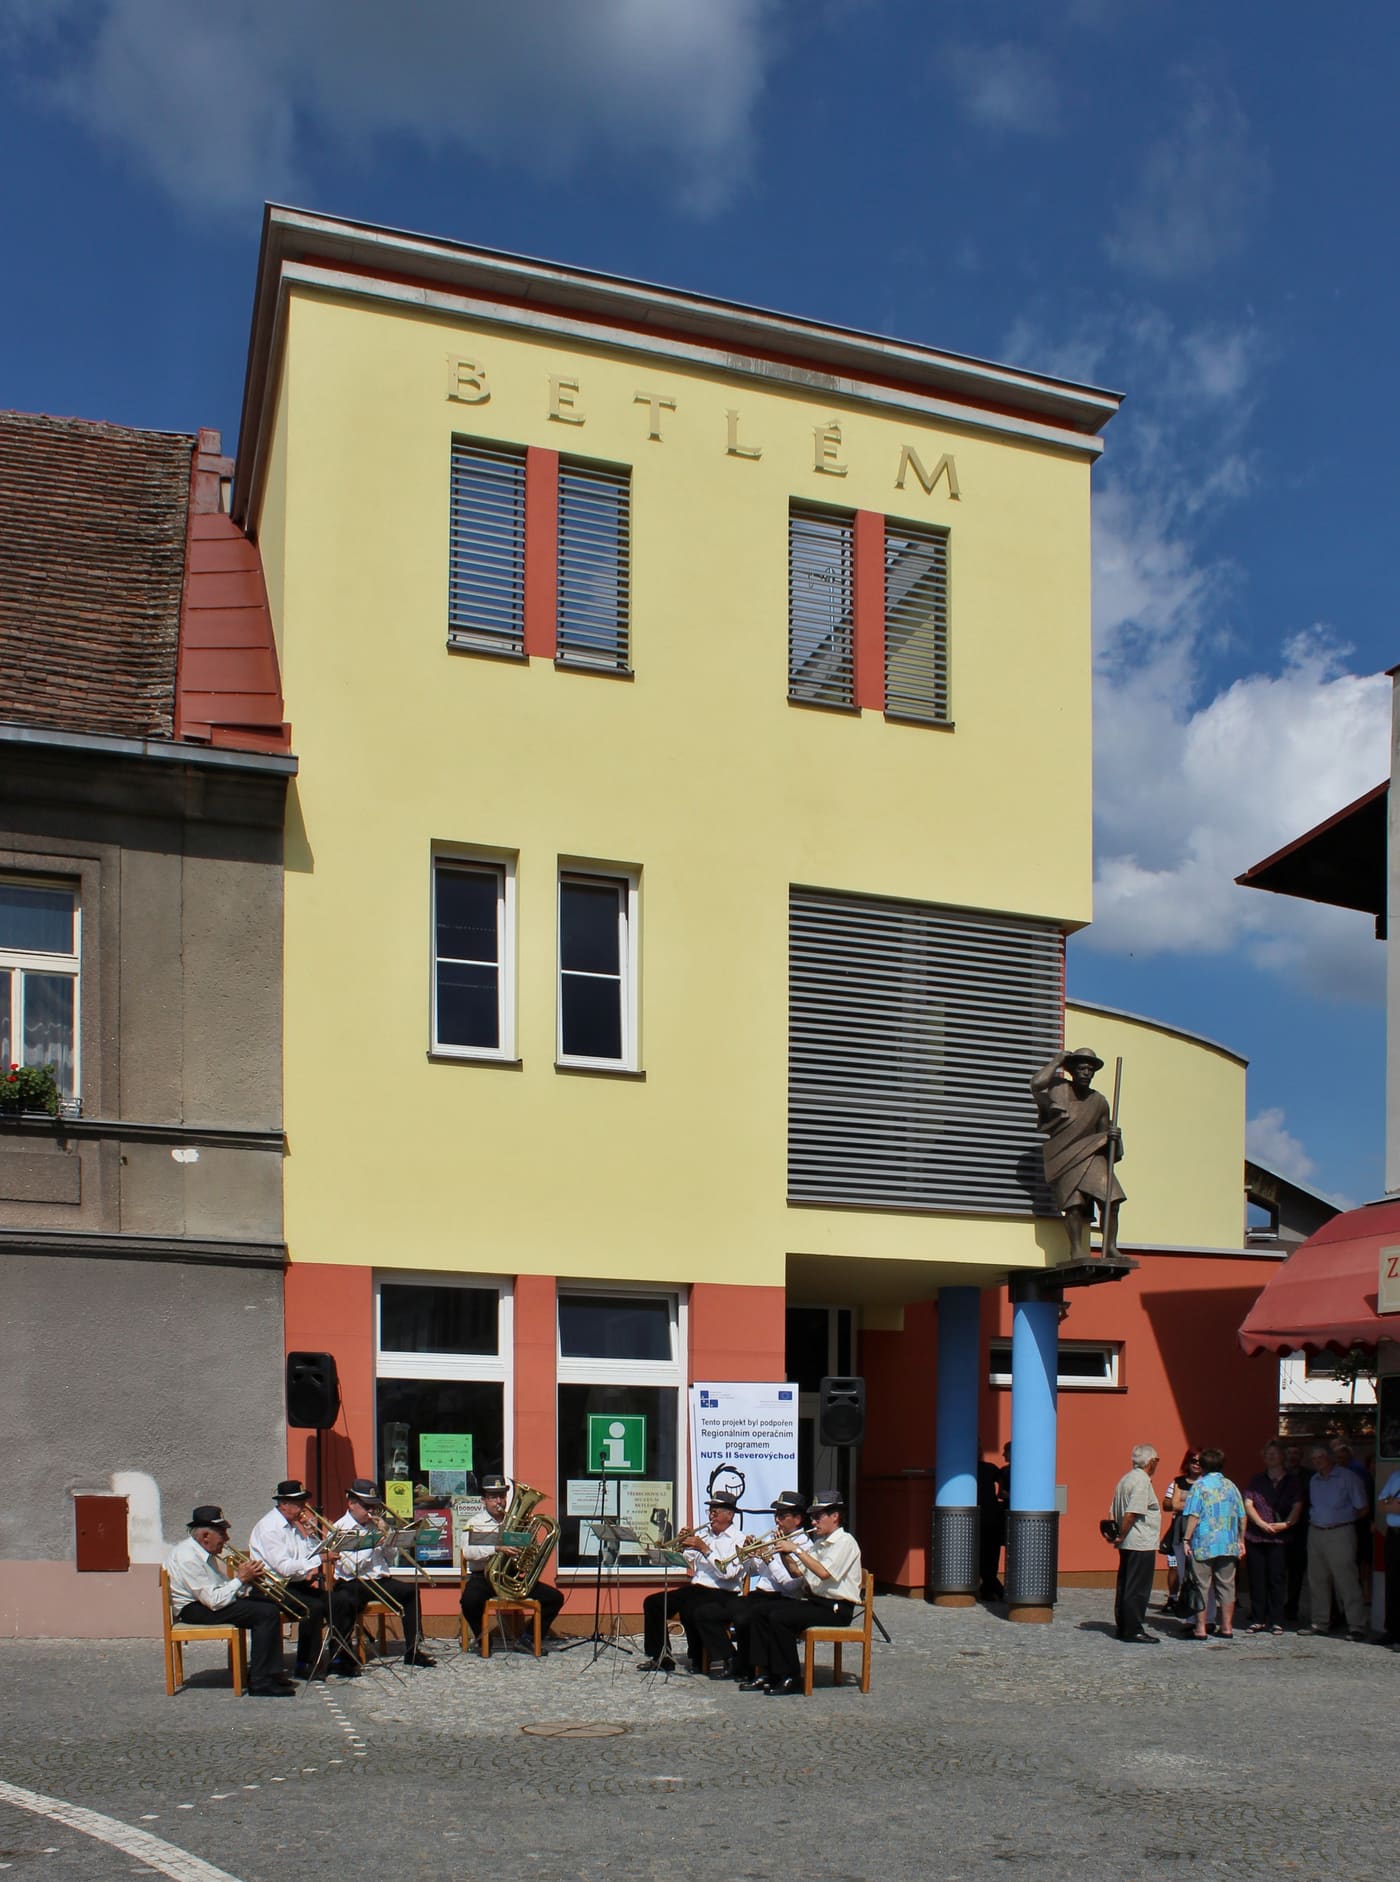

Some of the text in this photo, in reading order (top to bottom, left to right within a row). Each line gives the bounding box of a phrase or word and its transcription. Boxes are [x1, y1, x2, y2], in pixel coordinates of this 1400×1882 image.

[446, 352, 962, 500] BETLÉM
[701, 1418, 793, 1427] Tento projekt byl podpořen
[725, 1441, 770, 1450] programem
[700, 1451, 795, 1460] NUTS II Severovýchod
